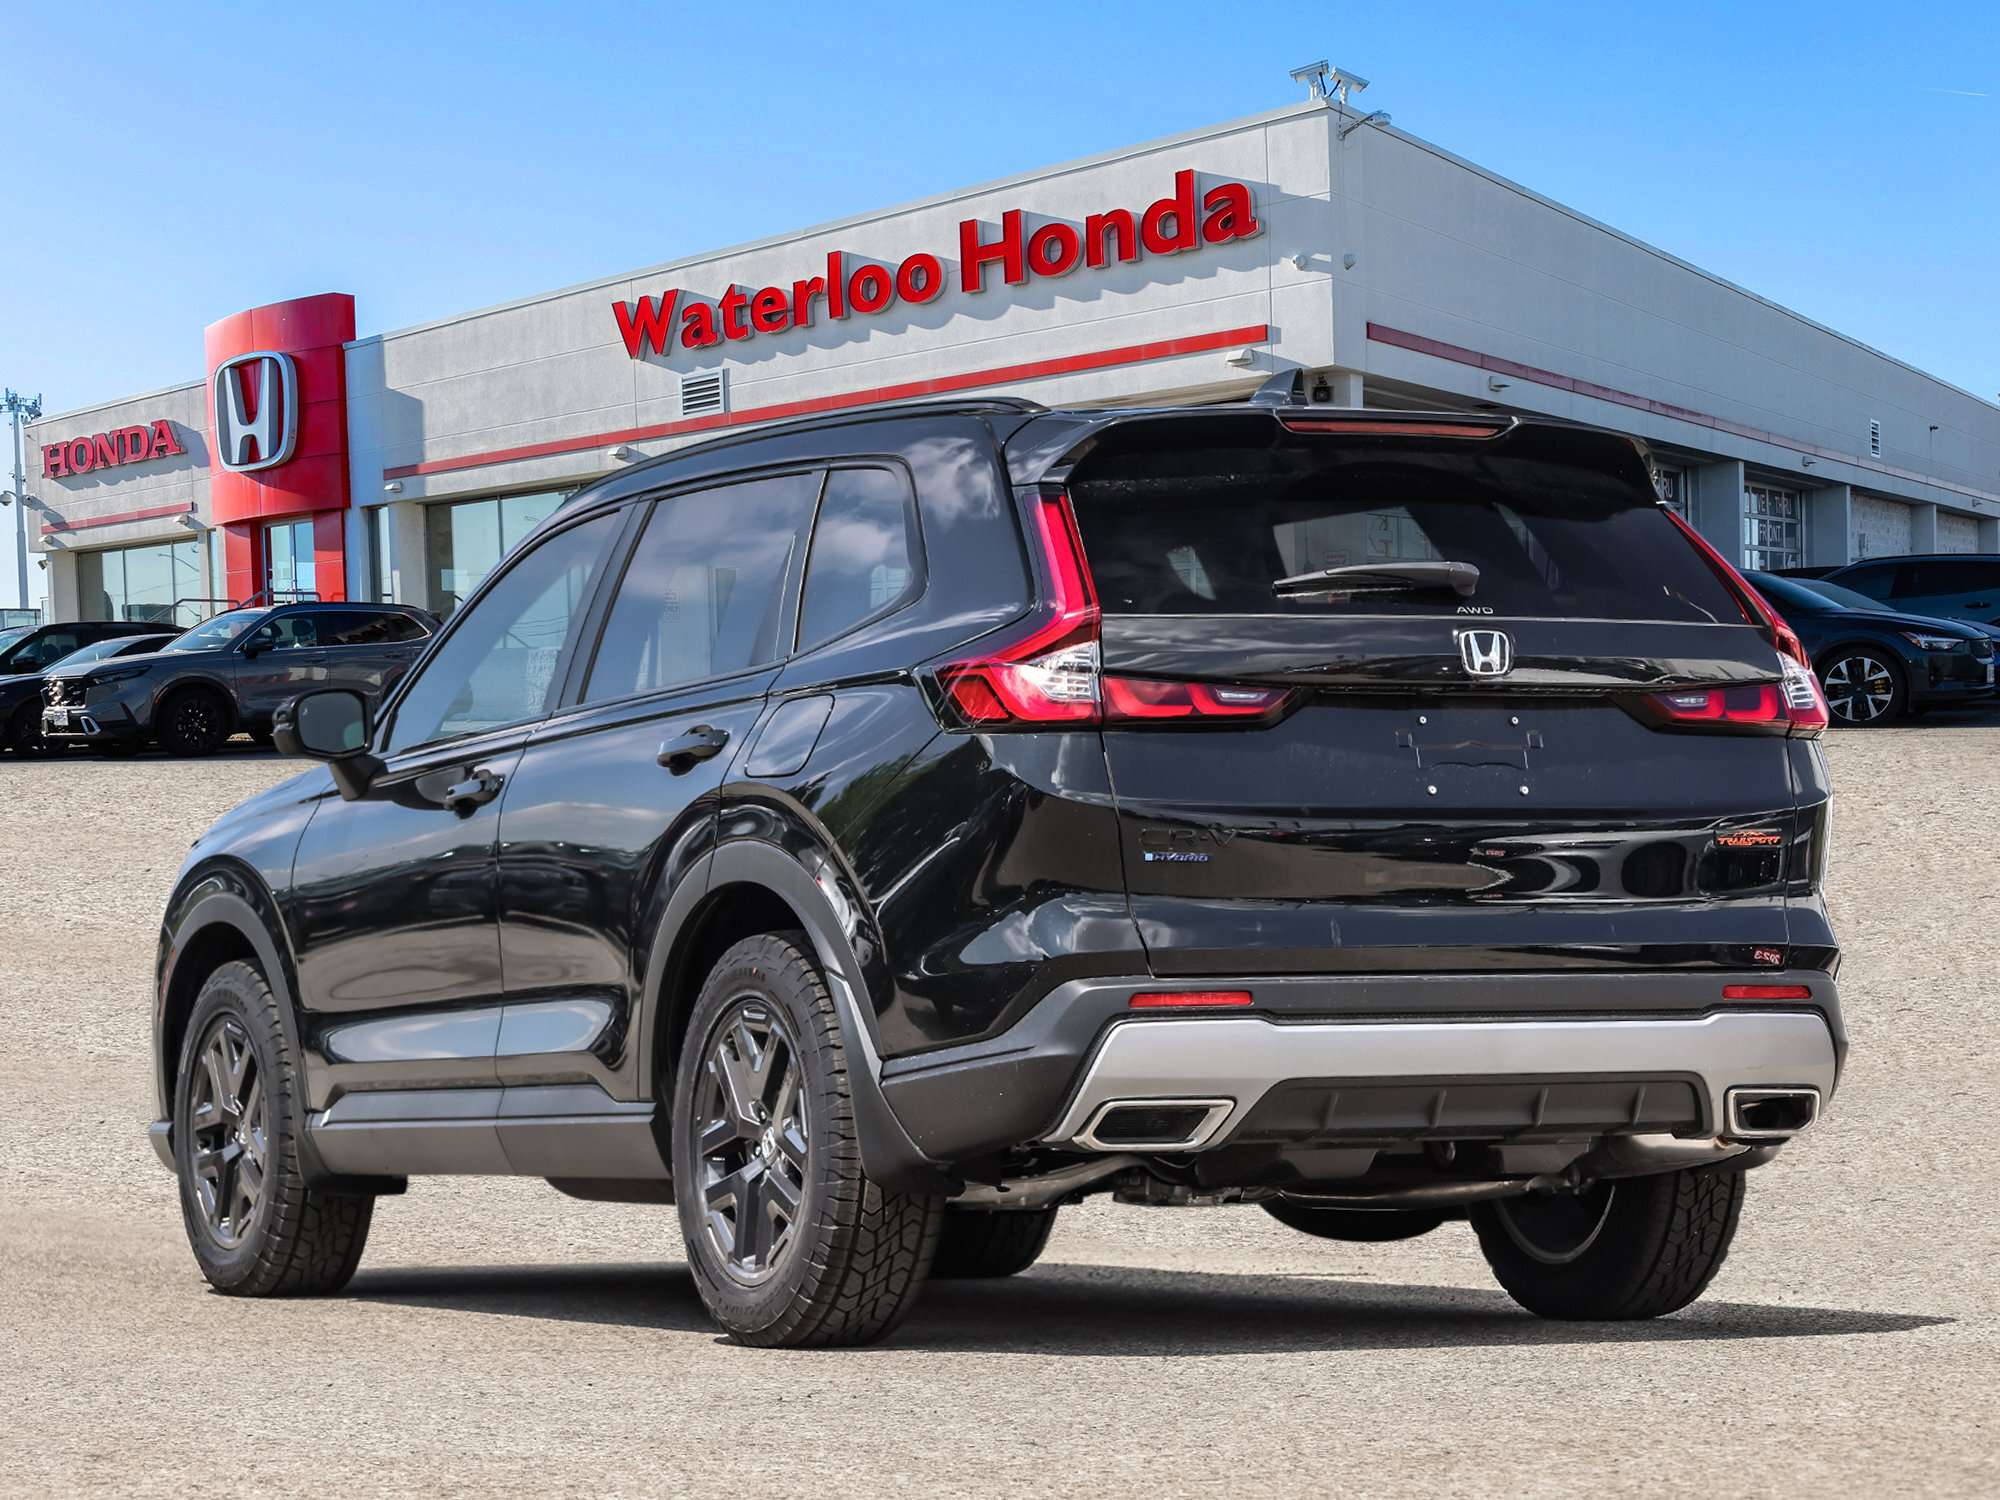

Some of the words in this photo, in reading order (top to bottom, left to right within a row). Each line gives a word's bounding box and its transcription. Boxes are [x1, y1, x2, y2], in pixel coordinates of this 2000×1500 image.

[612, 251, 945, 360] Waterloo
[960, 168, 1262, 294] Honda
[41, 419, 187, 480] HONDA
[1457, 606, 1494, 614] AWD
